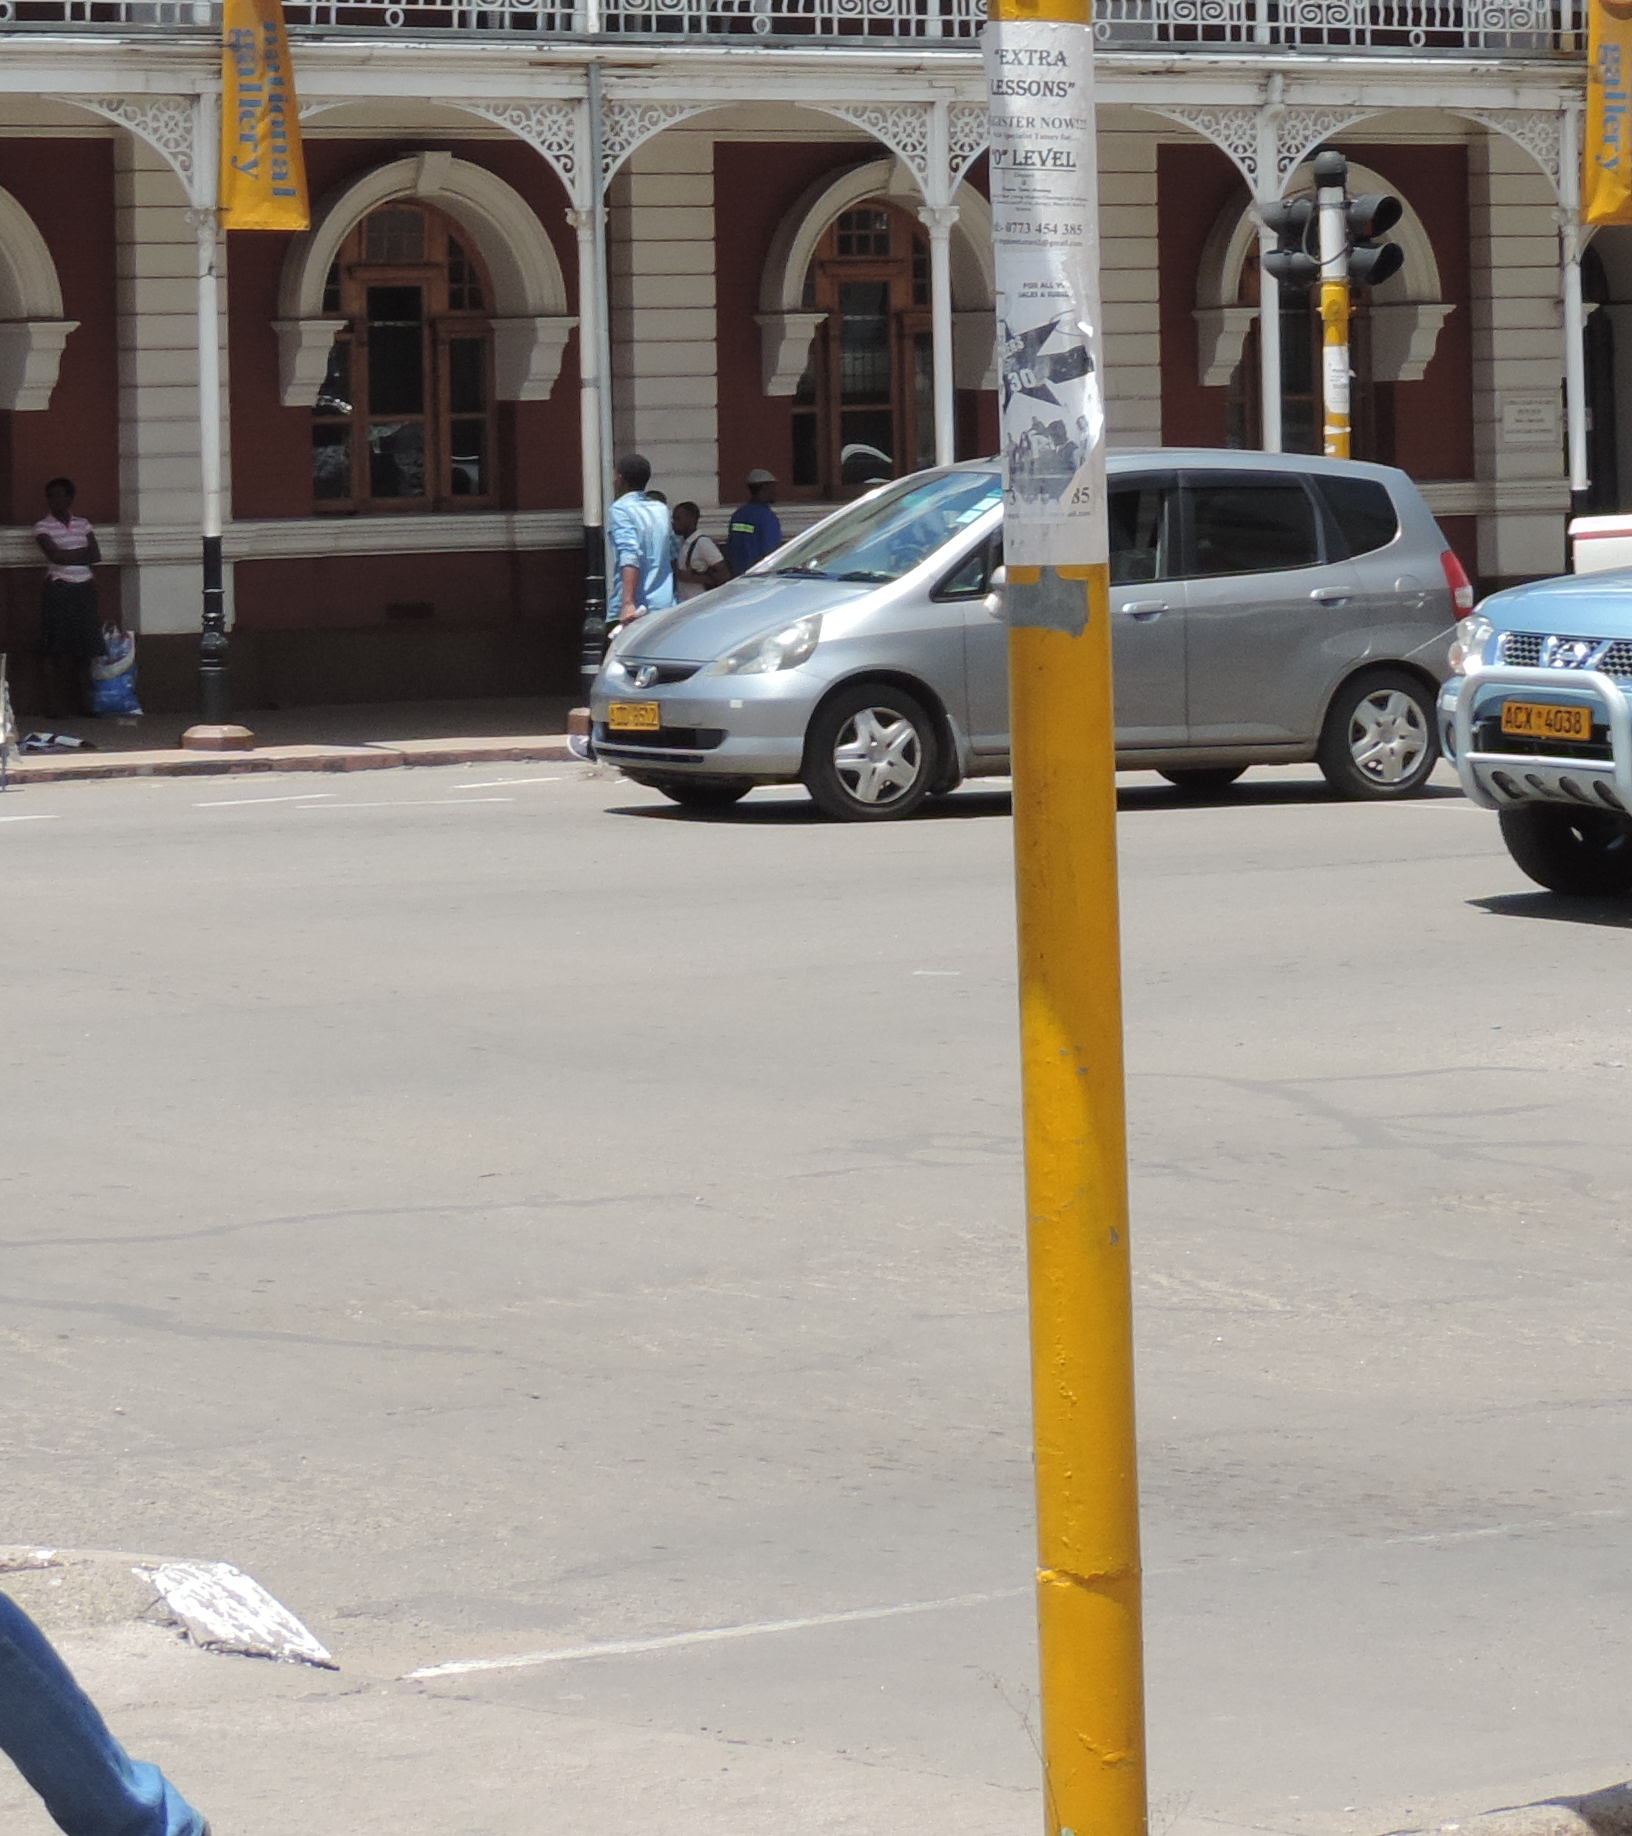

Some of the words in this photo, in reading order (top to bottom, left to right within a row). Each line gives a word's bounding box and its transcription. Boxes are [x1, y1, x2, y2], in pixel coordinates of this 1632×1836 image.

[1595, 44, 1627, 174] gallery
[1012, 148, 1077, 168] LEVEL
[1005, 222, 1031, 234] 0773
[1035, 223, 1058, 235] 454
[1061, 224, 1083, 236] 385
[1545, 710, 1582, 735] 4038
